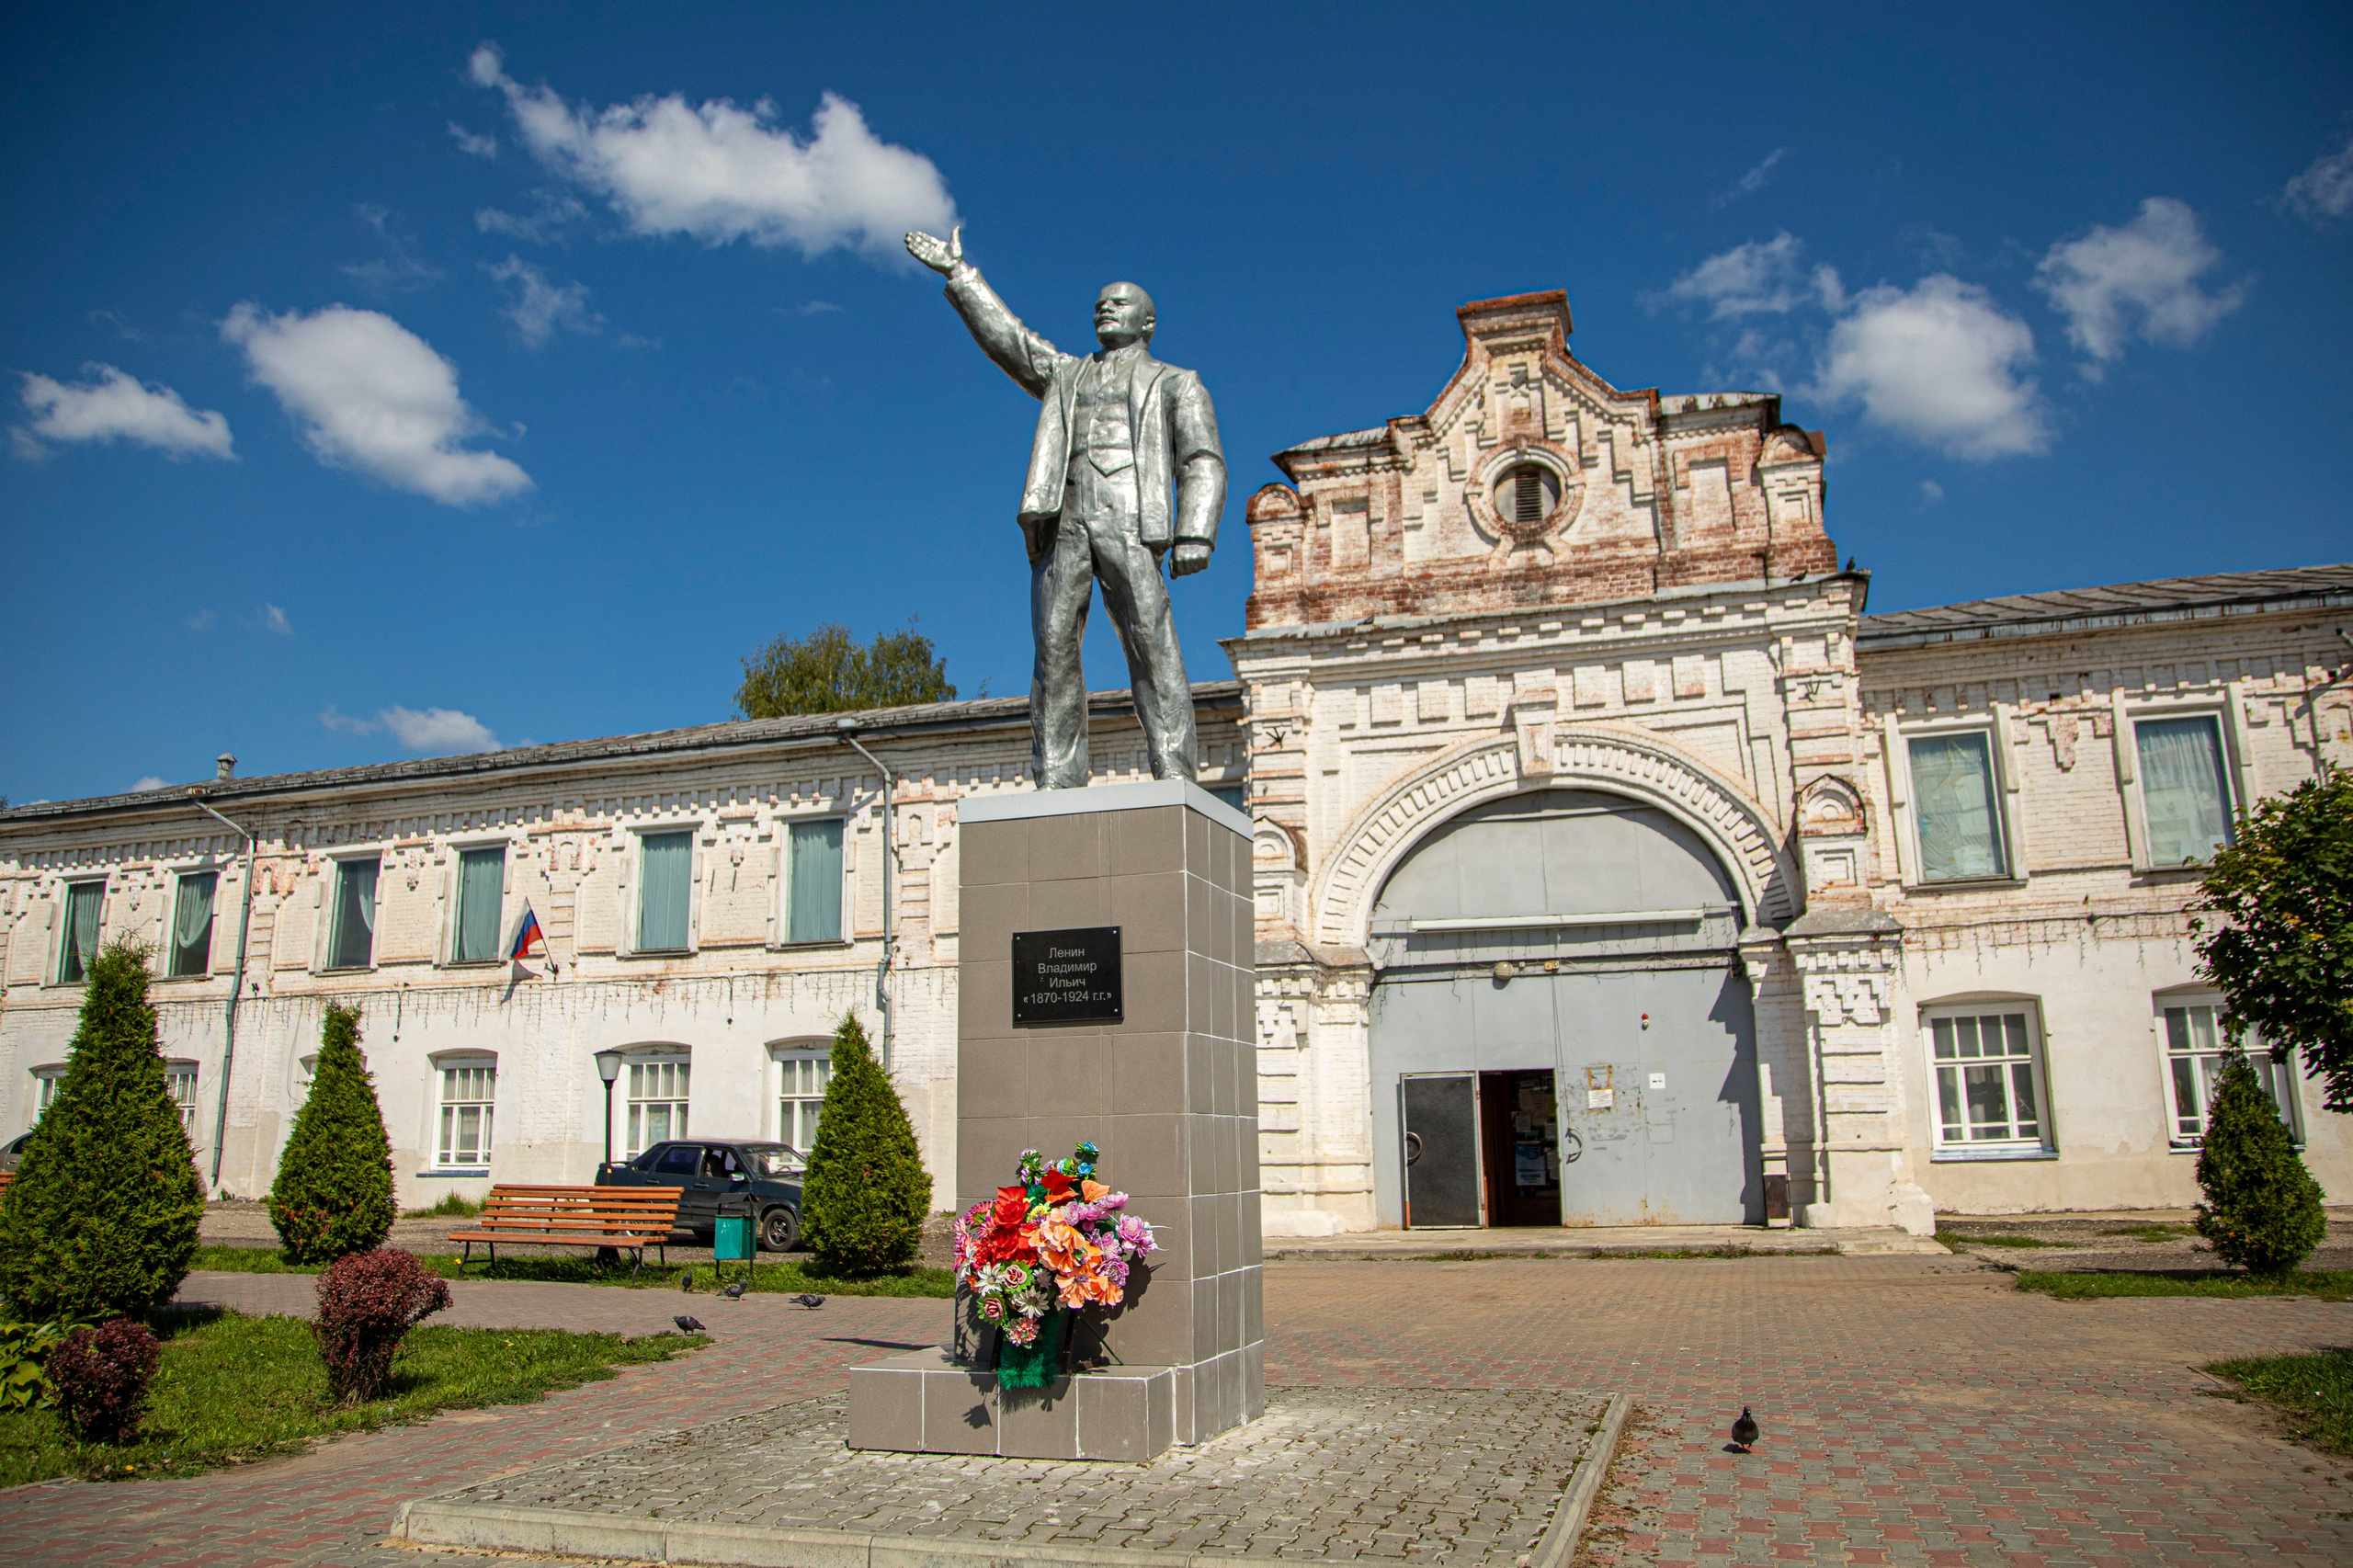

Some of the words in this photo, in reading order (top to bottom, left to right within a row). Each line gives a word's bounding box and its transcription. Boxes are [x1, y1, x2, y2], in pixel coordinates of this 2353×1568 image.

[1049, 948, 1085, 959] Ленин
[1038, 962, 1097, 974] Владимир
[1049, 977, 1086, 988] Ильич
